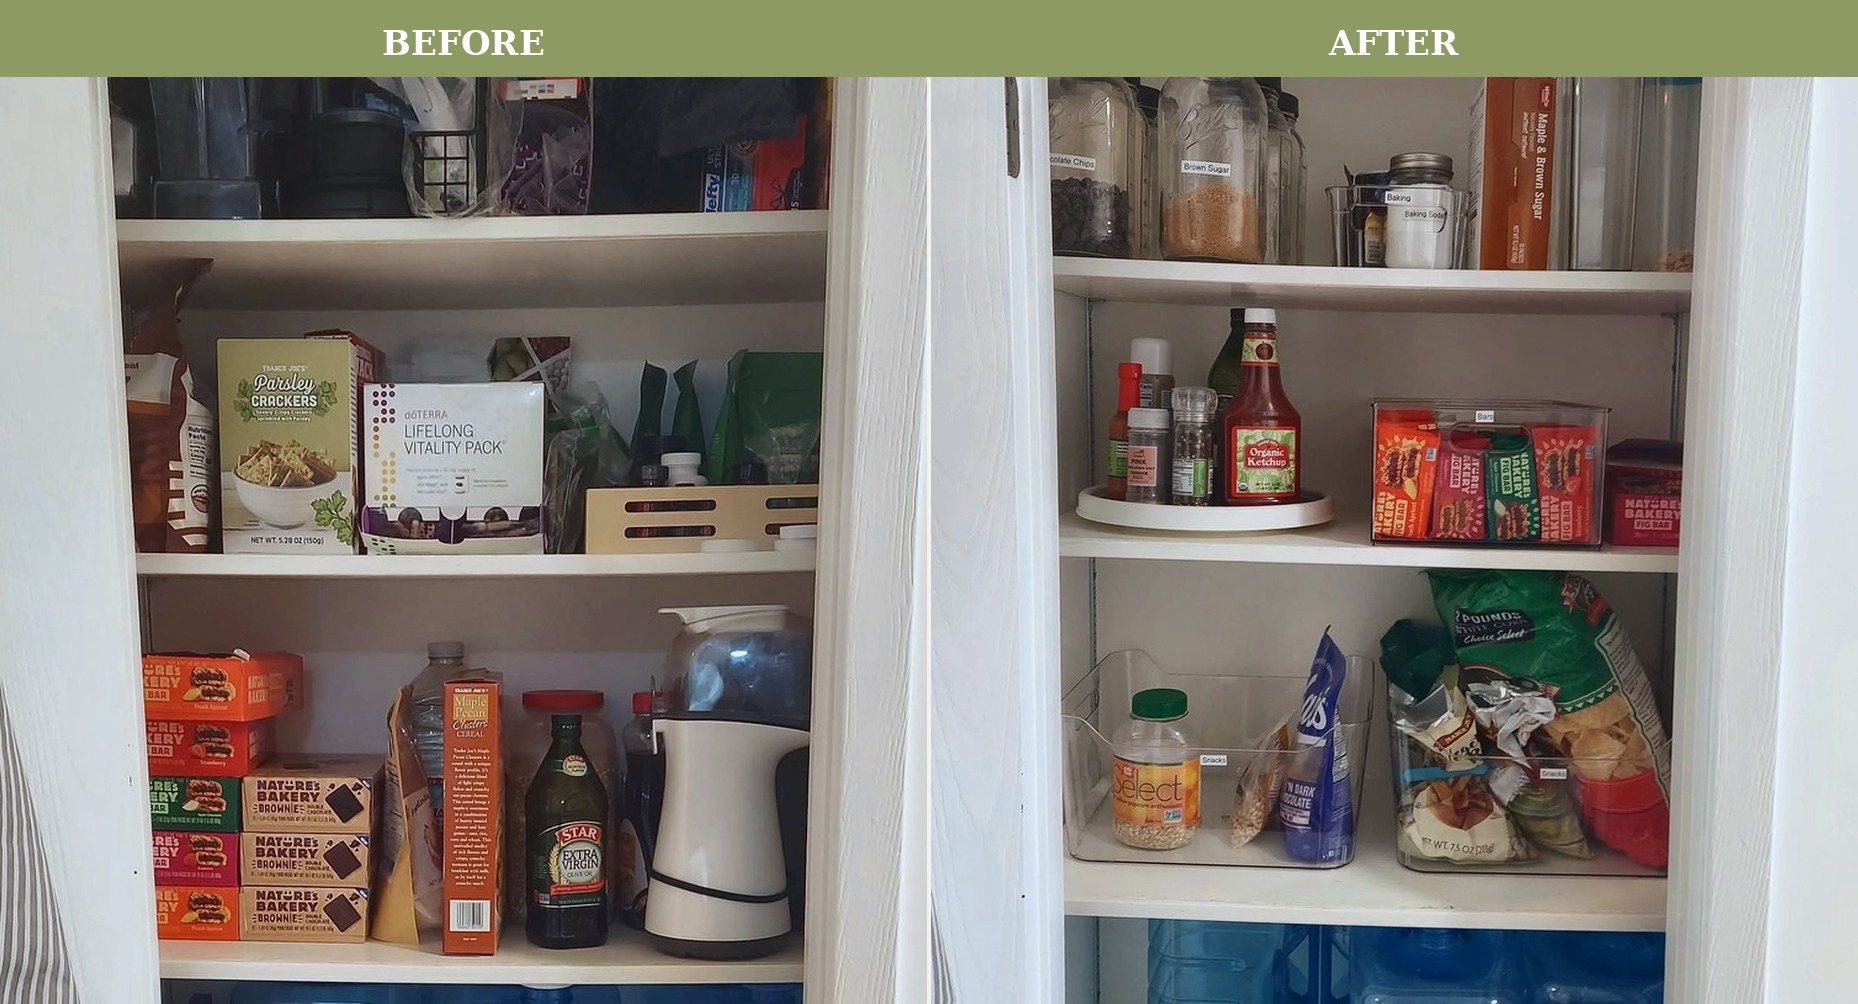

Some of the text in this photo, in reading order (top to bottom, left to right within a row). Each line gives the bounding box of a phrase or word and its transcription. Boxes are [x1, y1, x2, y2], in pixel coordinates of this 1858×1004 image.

[1536, 112, 1548, 144] Maple
[1050, 156, 1095, 169] colate Chips
[1184, 162, 1230, 174] Brown Sugar
[1535, 156, 1547, 189] Brown
[1387, 193, 1411, 203] Baking
[1532, 191, 1545, 220] Sugar
[1404, 210, 1427, 218] Baking
[254, 373, 316, 396] Parsley
[251, 395, 318, 407] CRACKERS
[1477, 412, 1494, 421] Bars
[404, 424, 474, 438] LIFELONG
[404, 441, 462, 455] VITALITY
[1249, 447, 1285, 458] Organic
[1247, 457, 1287, 468] Ketchup
[1451, 468, 1461, 486] BAR
[1502, 460, 1512, 492] FIG BAR
[1382, 491, 1396, 535] AKERY
[1396, 503, 1406, 521] BAR
[1550, 495, 1560, 539] AKERY
[1625, 509, 1681, 520] BAKERY
[1562, 504, 1571, 539] FIG BAR
[1652, 521, 1670, 529] BAR
[1462, 612, 1522, 624] POUNDS
[1463, 628, 1526, 644] Choice Select
[148, 690, 167, 699] BAR
[455, 695, 487, 709] Maple
[455, 707, 486, 718] Pecan
[452, 719, 489, 731] Clusters
[456, 730, 485, 738] CEREAL
[151, 747, 170, 756] BAR
[1202, 756, 1227, 764] Snacks
[1114, 763, 1182, 802] Select
[257, 792, 320, 802] BAKERY
[1294, 784, 1317, 798] DARK
[258, 803, 300, 813] BROWNIE
[561, 826, 598, 842] STAR
[256, 847, 319, 858] BAKERY
[562, 849, 598, 860] EXTRA
[257, 859, 298, 869] BROWNIE
[561, 860, 599, 870] VIRGIN
[256, 902, 319, 912] BAKERY
[258, 913, 298, 923] BROWNIE
